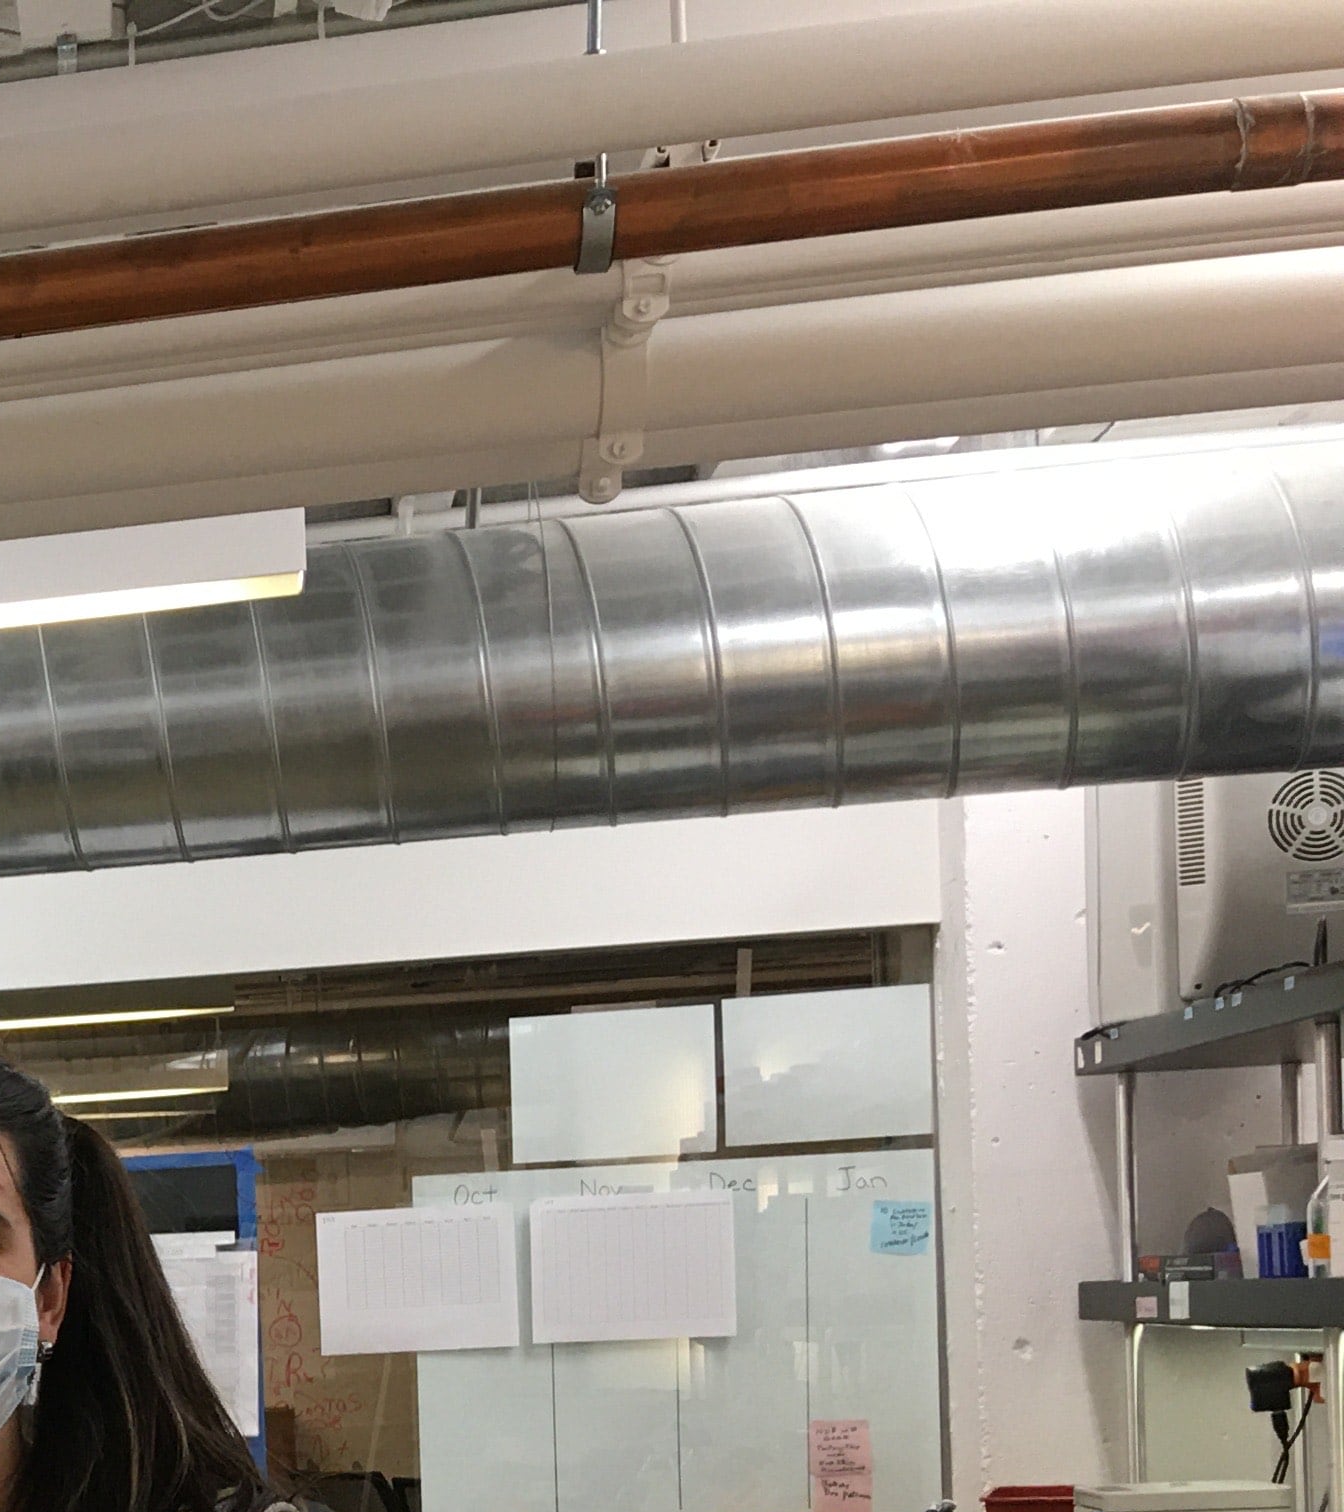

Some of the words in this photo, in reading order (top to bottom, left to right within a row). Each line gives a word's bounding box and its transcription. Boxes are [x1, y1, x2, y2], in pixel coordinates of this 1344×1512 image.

[453, 1184, 499, 1205] Oct
[579, 1179, 625, 1197] Nov
[708, 1171, 757, 1192] Dec
[837, 1165, 888, 1190] Jan
